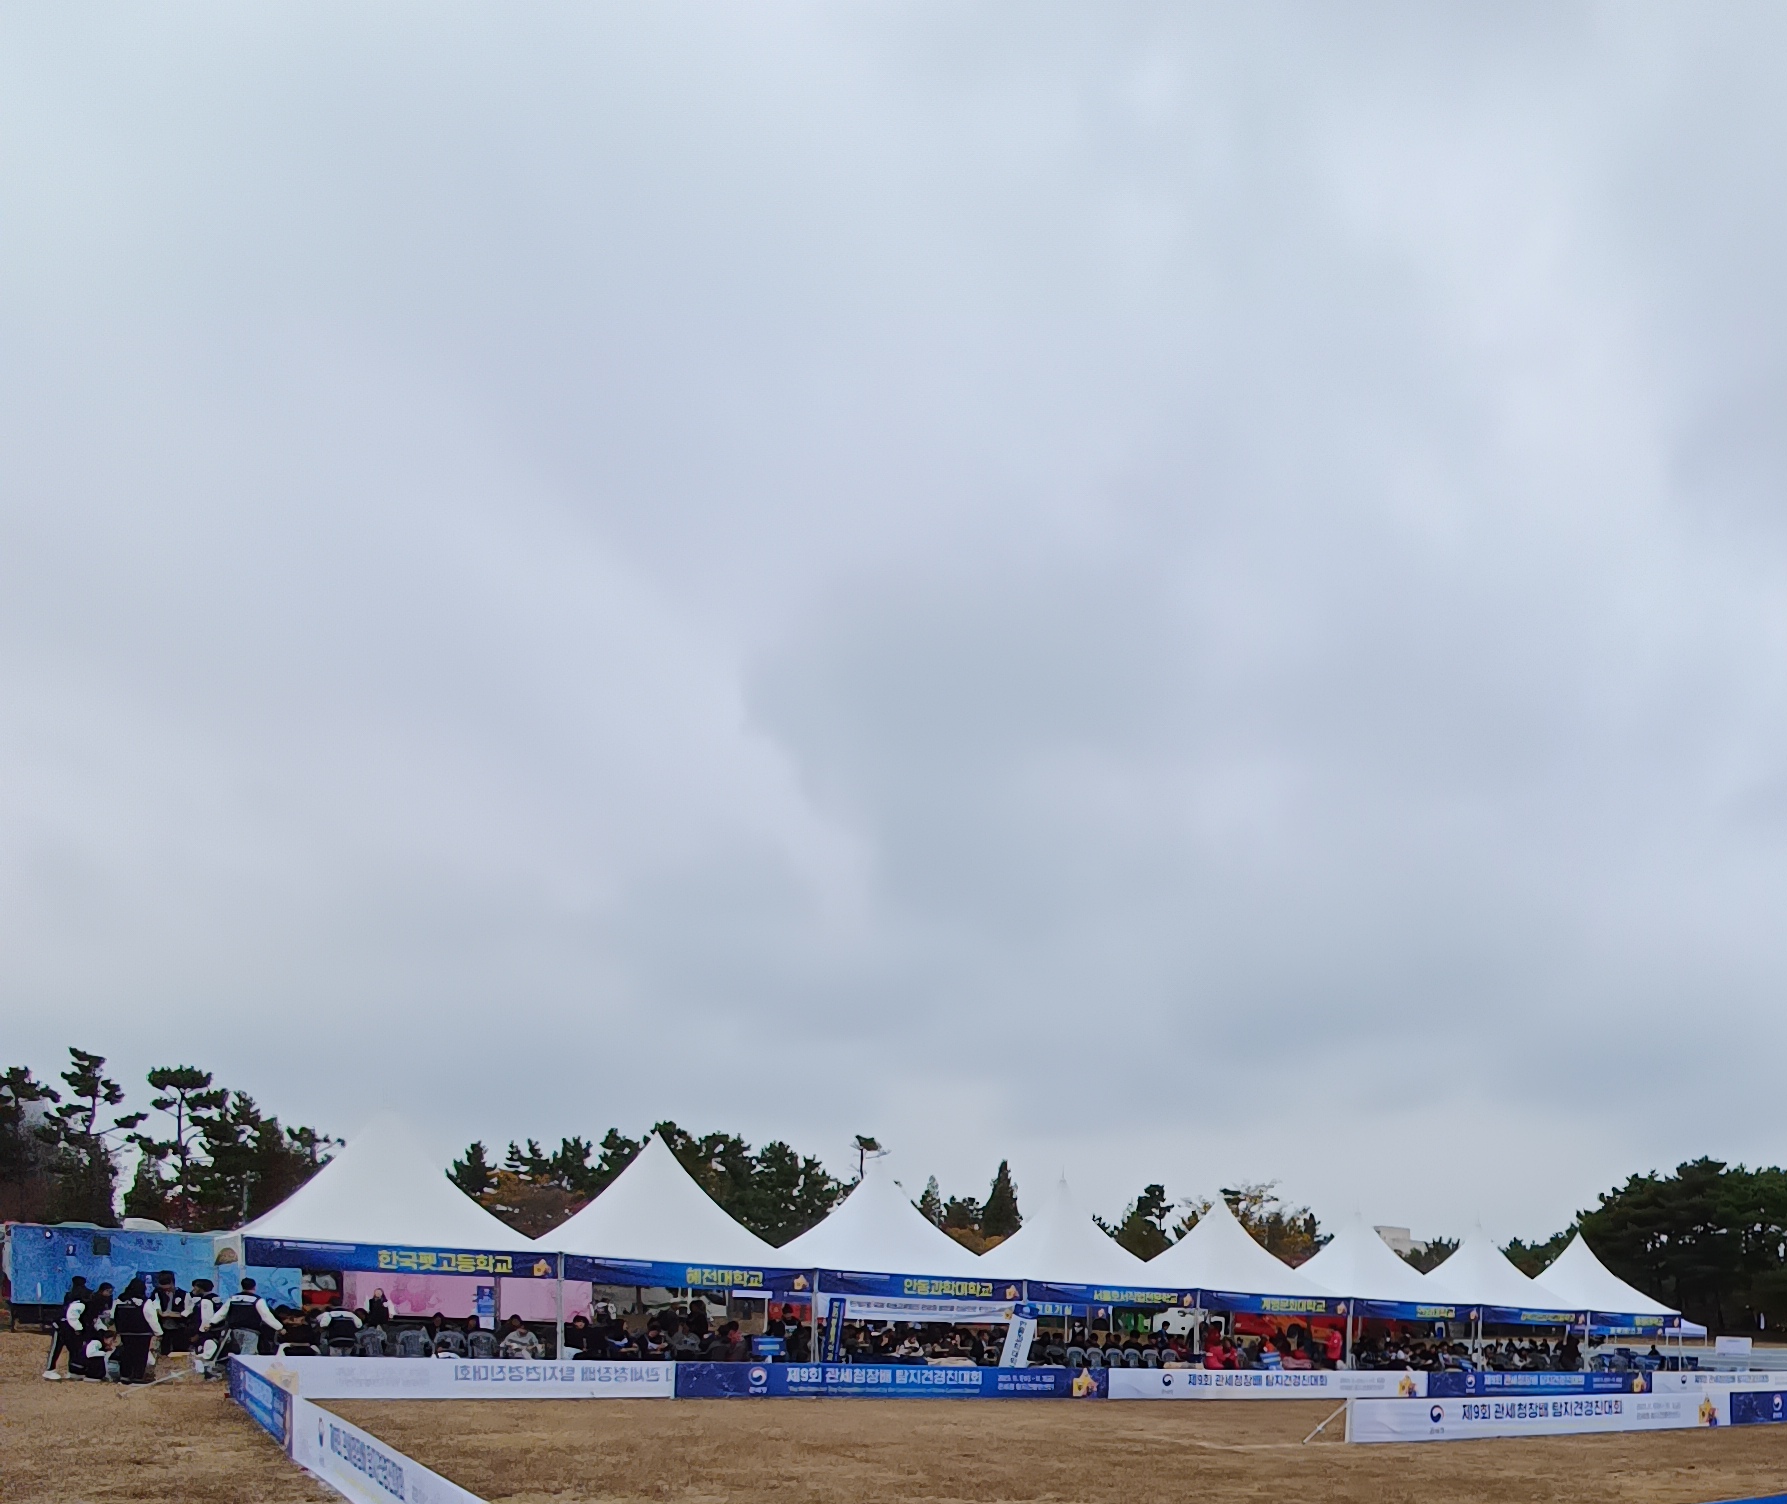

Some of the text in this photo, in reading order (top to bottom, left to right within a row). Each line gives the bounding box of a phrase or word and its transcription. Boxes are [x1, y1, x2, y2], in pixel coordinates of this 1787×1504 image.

[903, 1278, 993, 1298] 안동과학대학교
[1462, 1404, 1491, 1421] 제9회
[1494, 1402, 1549, 1420] 관세청장배
[1552, 1399, 1623, 1417] 탐지견경진대회
